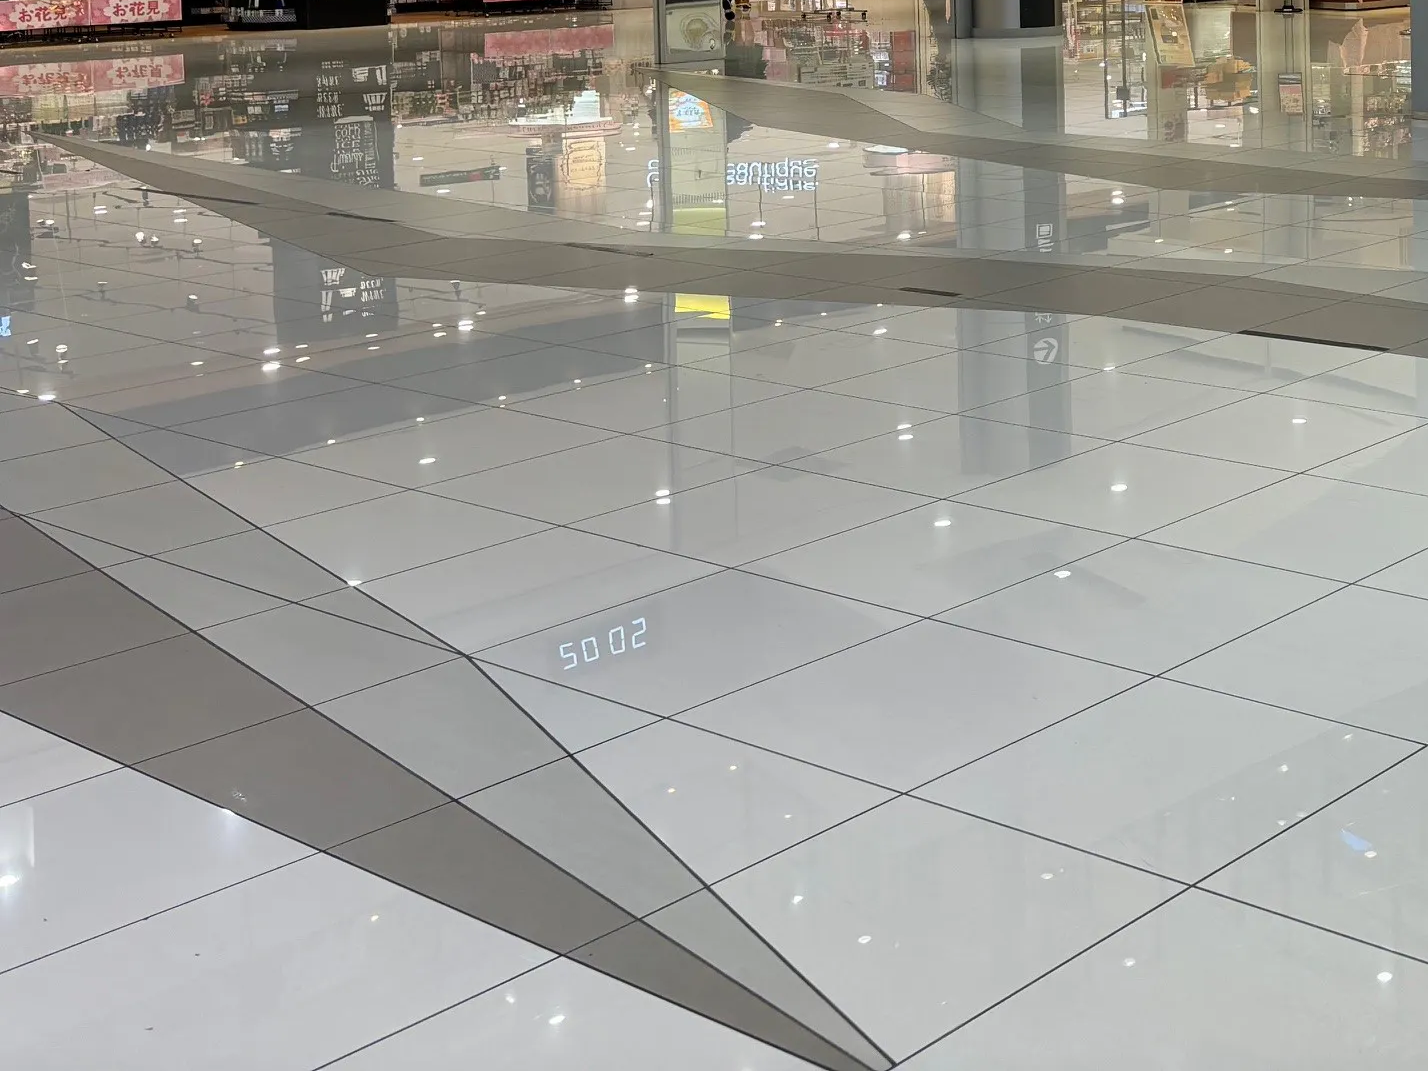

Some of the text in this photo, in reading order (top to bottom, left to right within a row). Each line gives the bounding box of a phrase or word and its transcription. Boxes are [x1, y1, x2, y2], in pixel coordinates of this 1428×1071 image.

[18, 6, 68, 23] お花見
[113, 0, 161, 17] お花見
